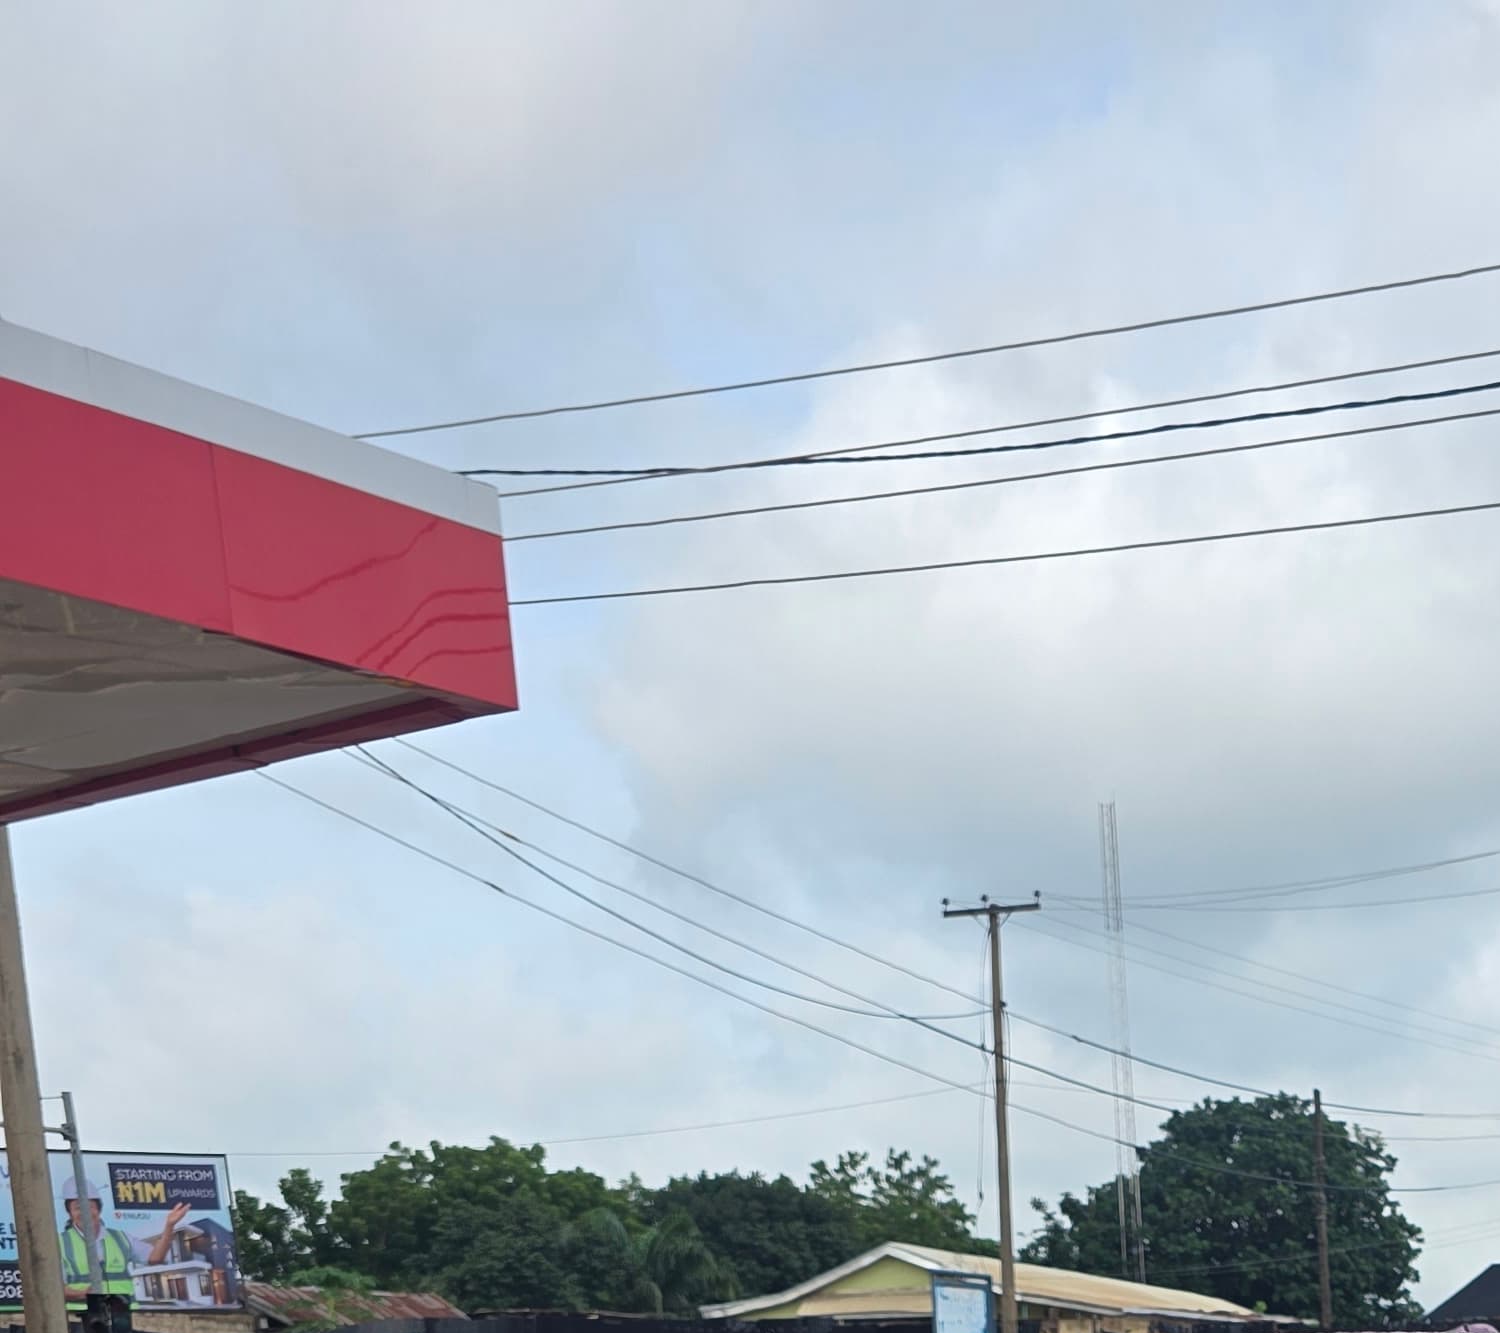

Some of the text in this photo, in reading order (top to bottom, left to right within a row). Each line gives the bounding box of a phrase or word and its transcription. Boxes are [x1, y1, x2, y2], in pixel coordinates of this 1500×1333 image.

[115, 1168, 214, 1181] STARTING FROM
[167, 1188, 216, 1199] UPWARDS
